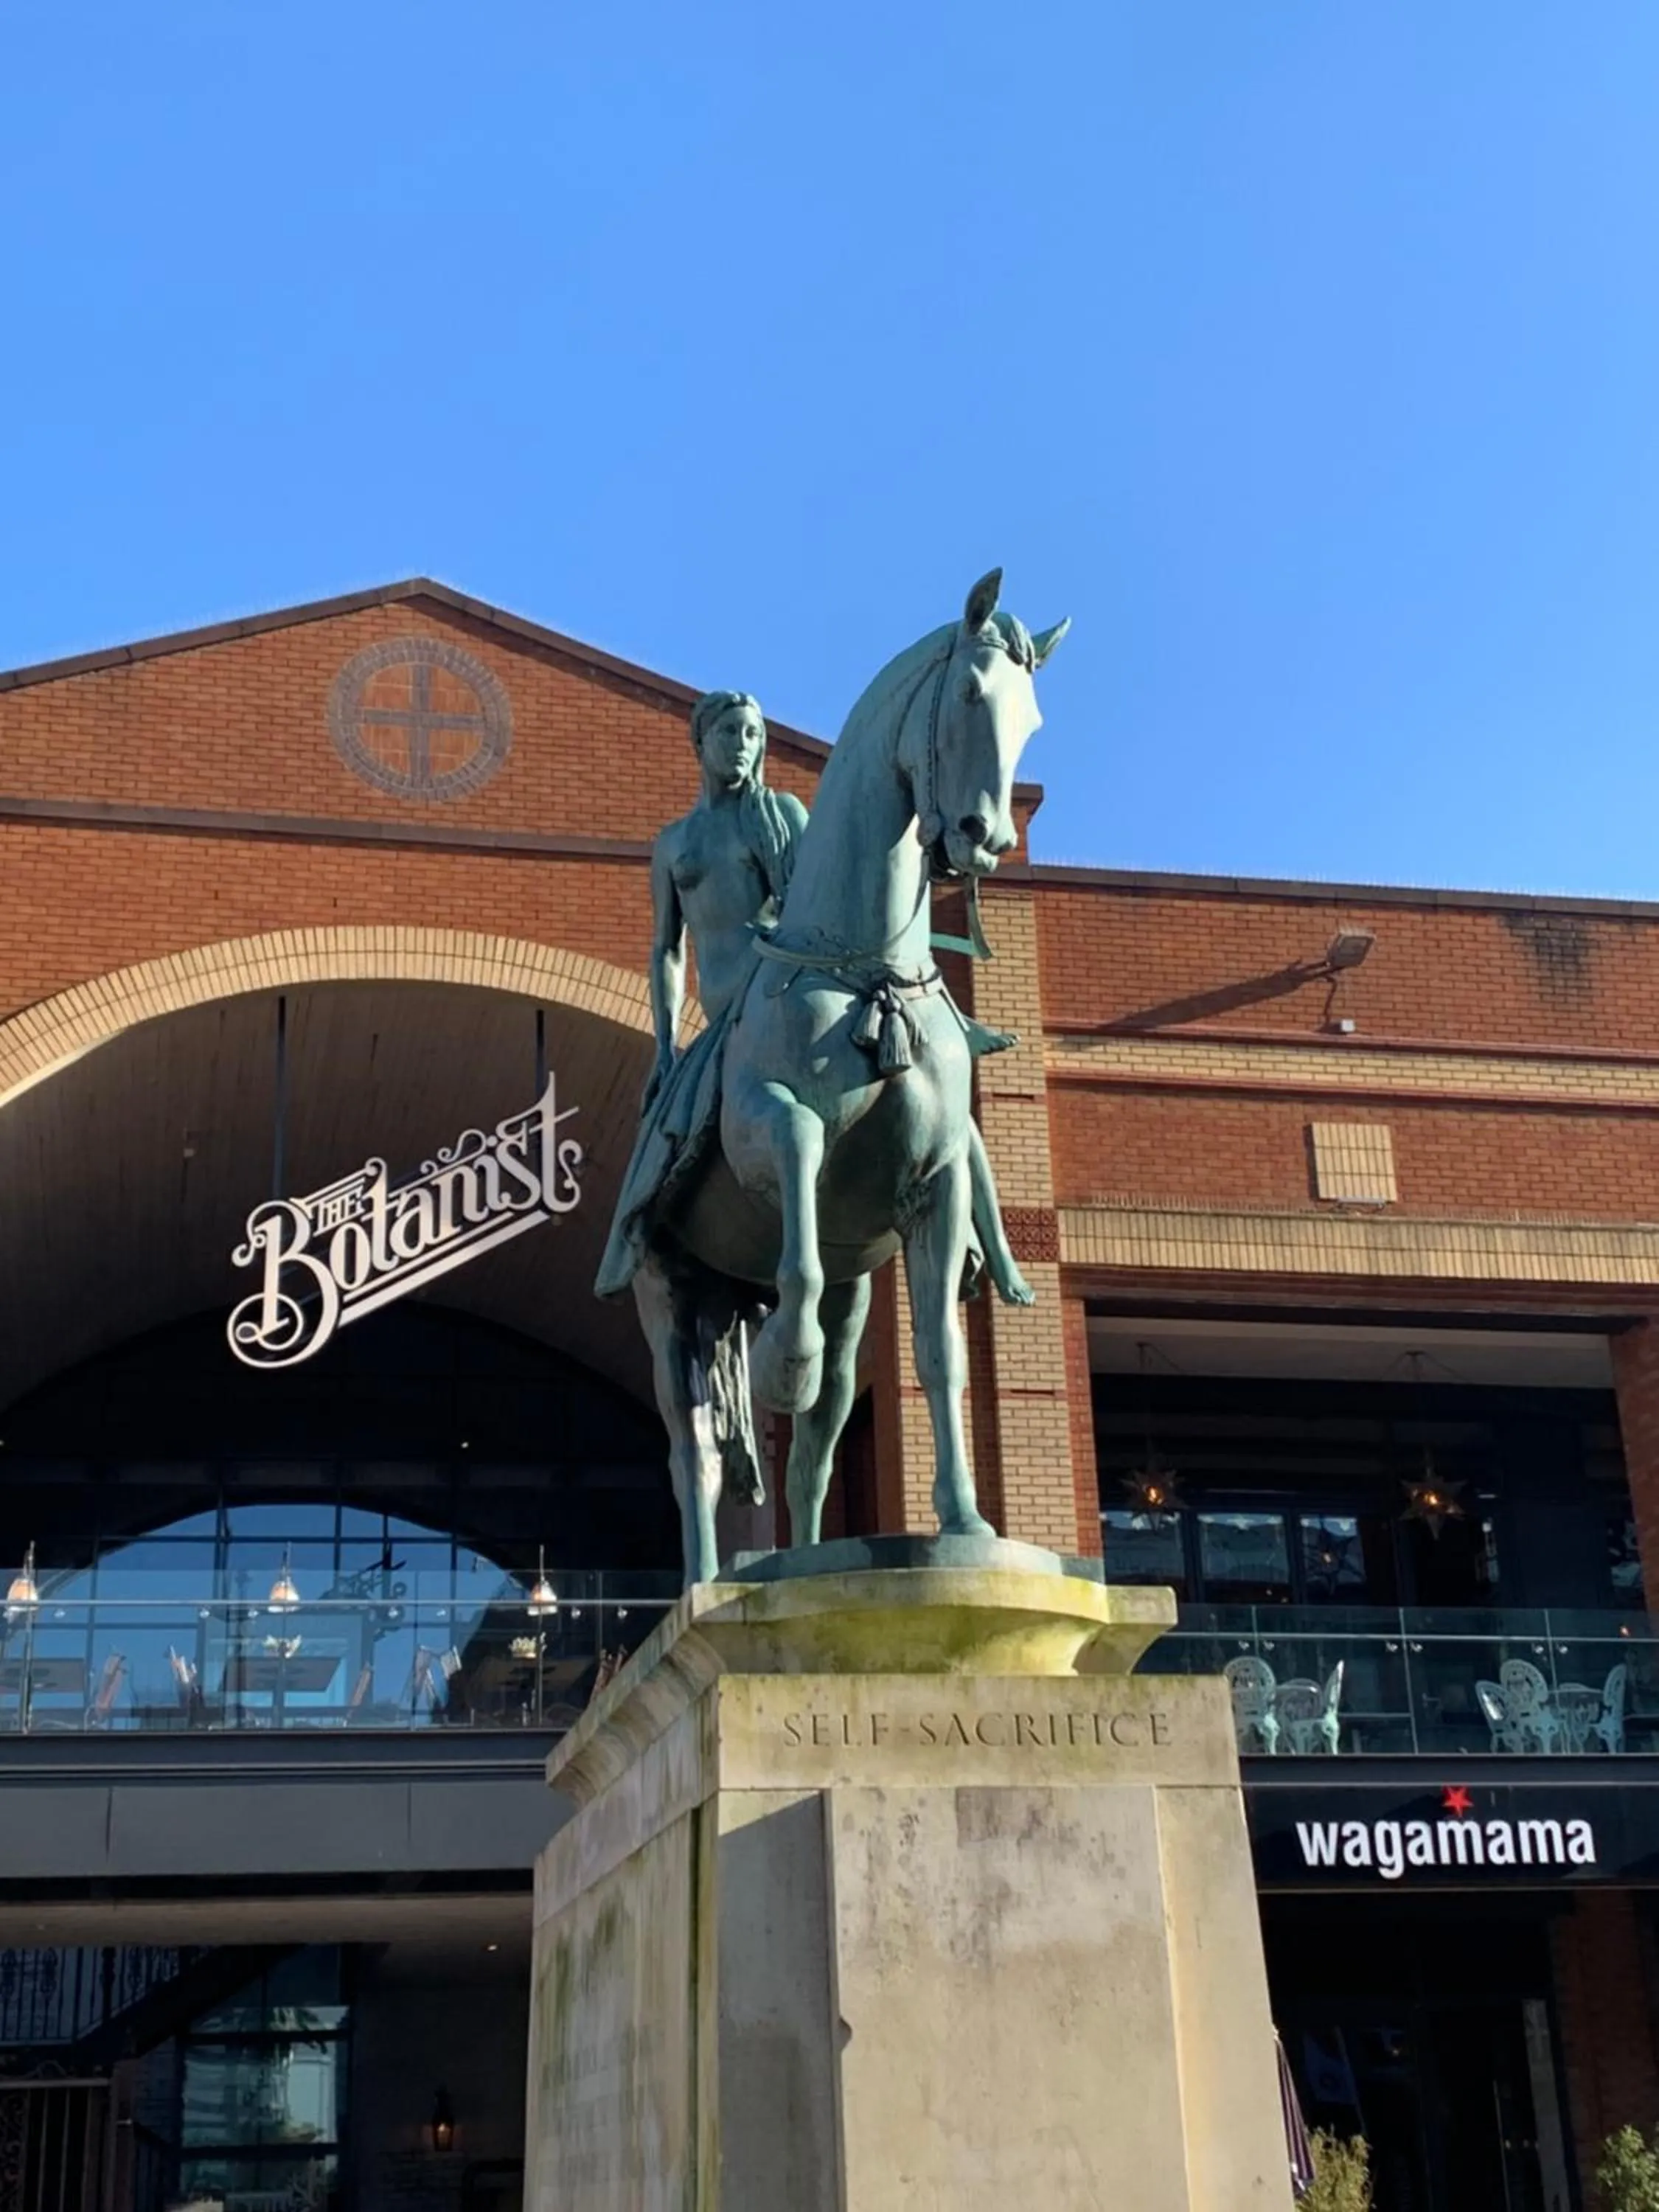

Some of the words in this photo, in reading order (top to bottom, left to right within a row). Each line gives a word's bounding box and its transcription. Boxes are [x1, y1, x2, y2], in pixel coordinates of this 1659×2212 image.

[227, 1071, 583, 1368] Botanist
[305, 1179, 366, 1237] THE
[1295, 1819, 1596, 1879] wagamama
